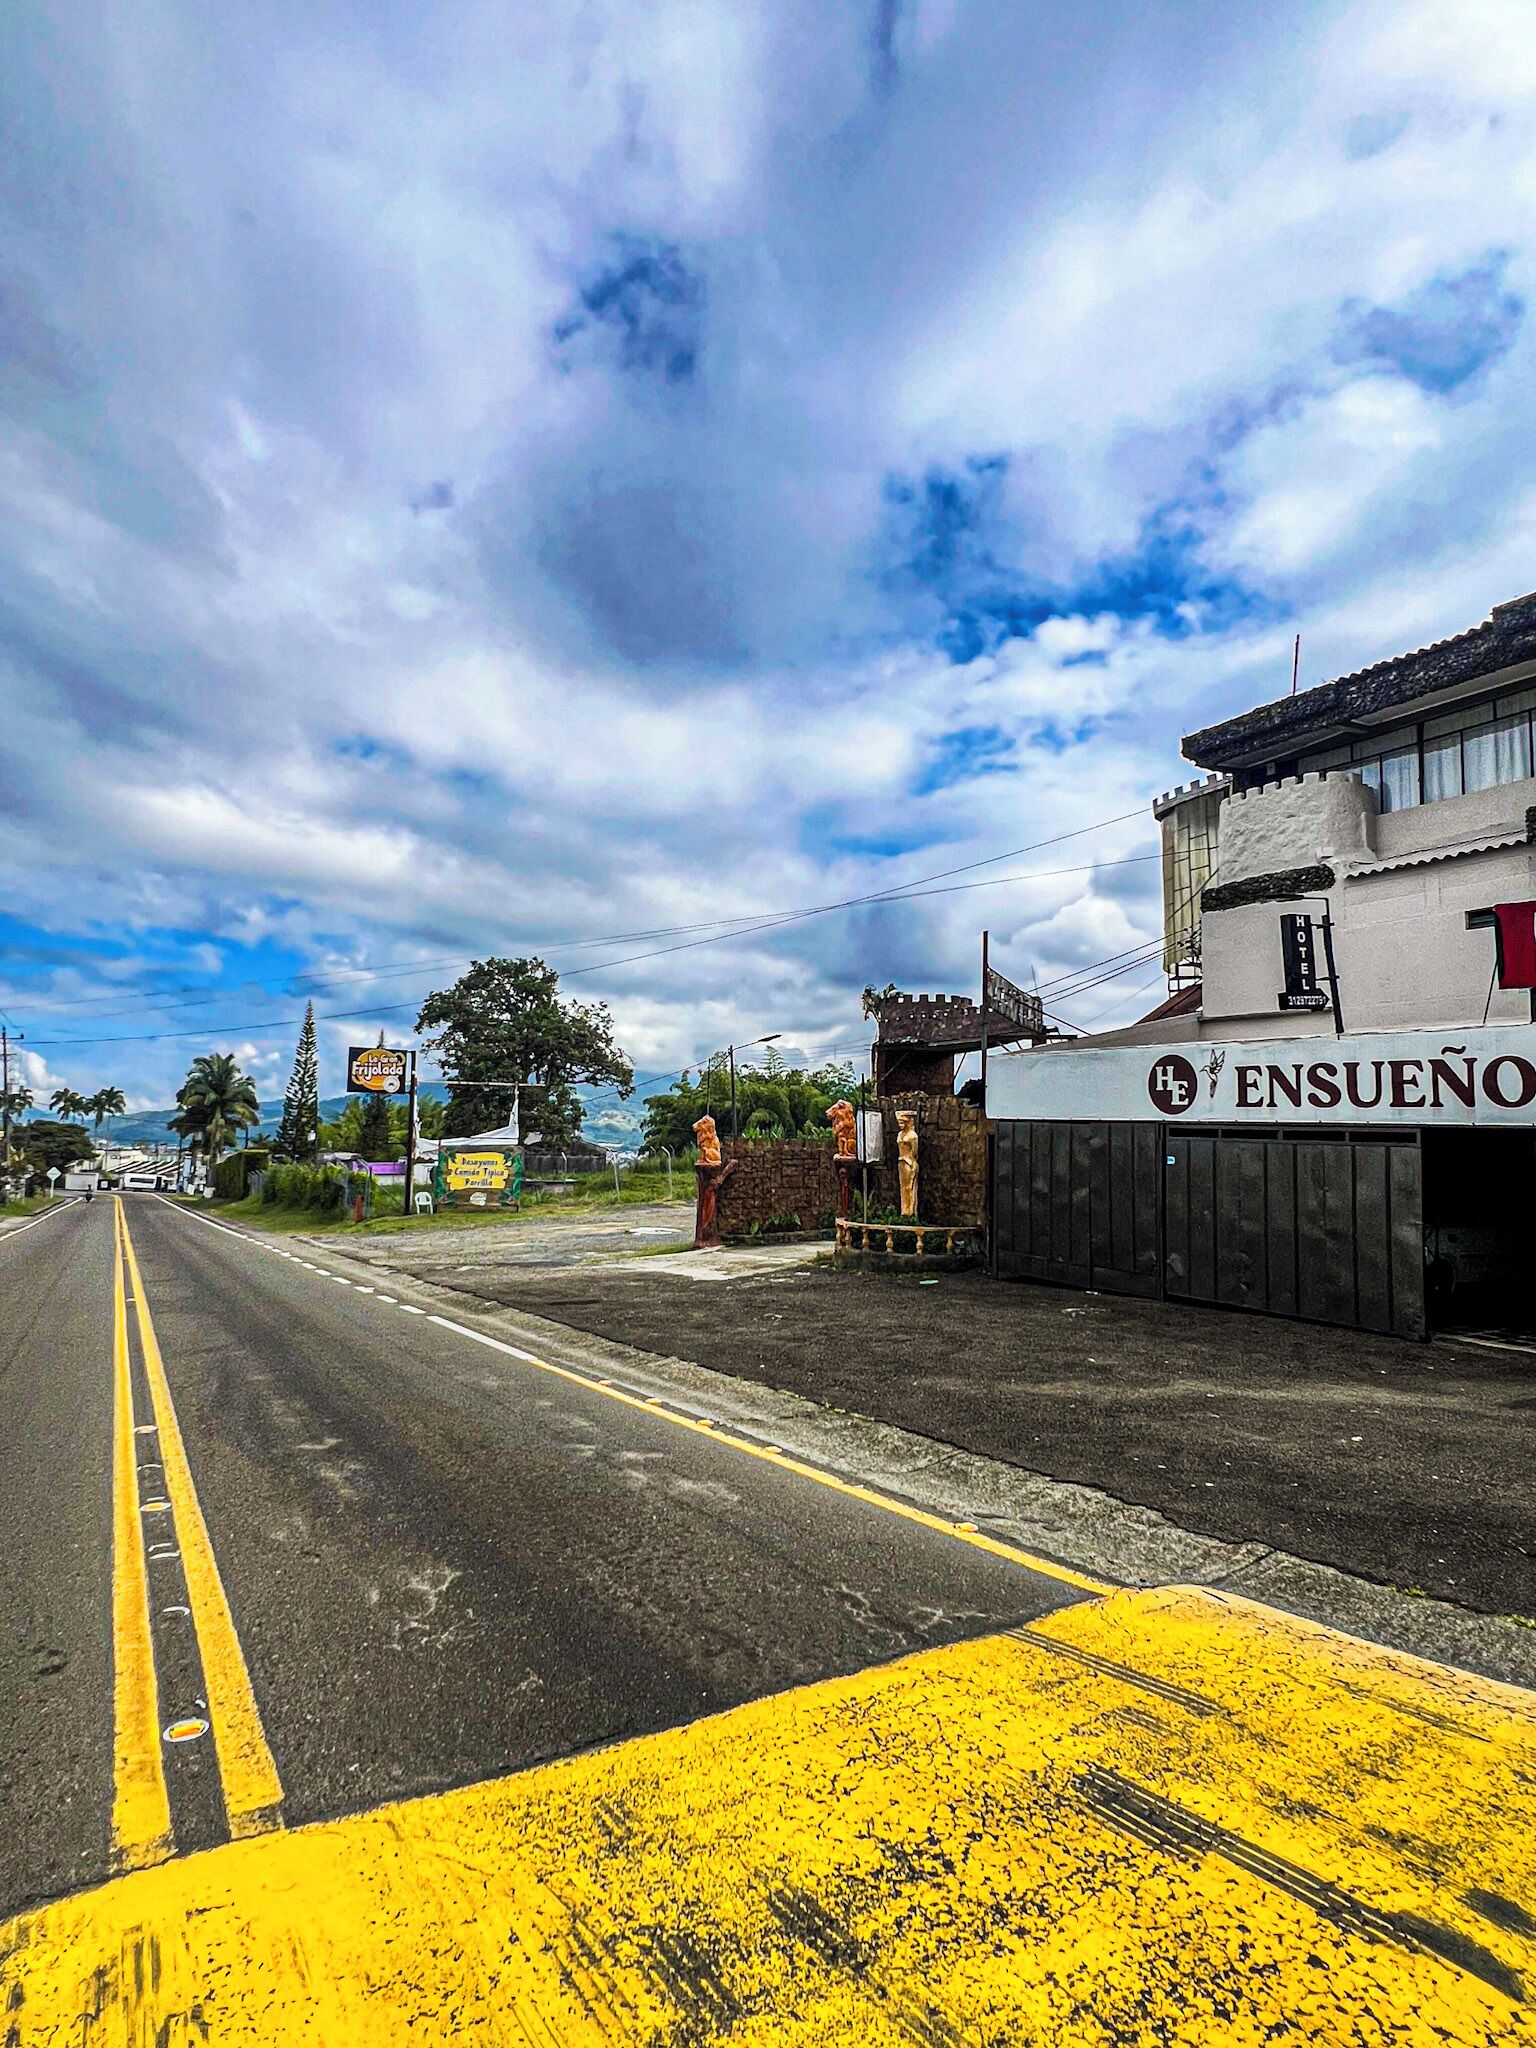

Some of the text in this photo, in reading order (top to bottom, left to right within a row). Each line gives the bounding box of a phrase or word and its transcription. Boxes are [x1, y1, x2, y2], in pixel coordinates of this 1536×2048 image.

[1296, 916, 1310, 990] HOTEL
[368, 1054, 398, 1063] La Gran
[352, 1061, 404, 1080] Frijolada
[1234, 1045, 1536, 1109] ENSUEÑO
[454, 1167, 480, 1176] Comida
[465, 1178, 493, 1187] Parrilla
